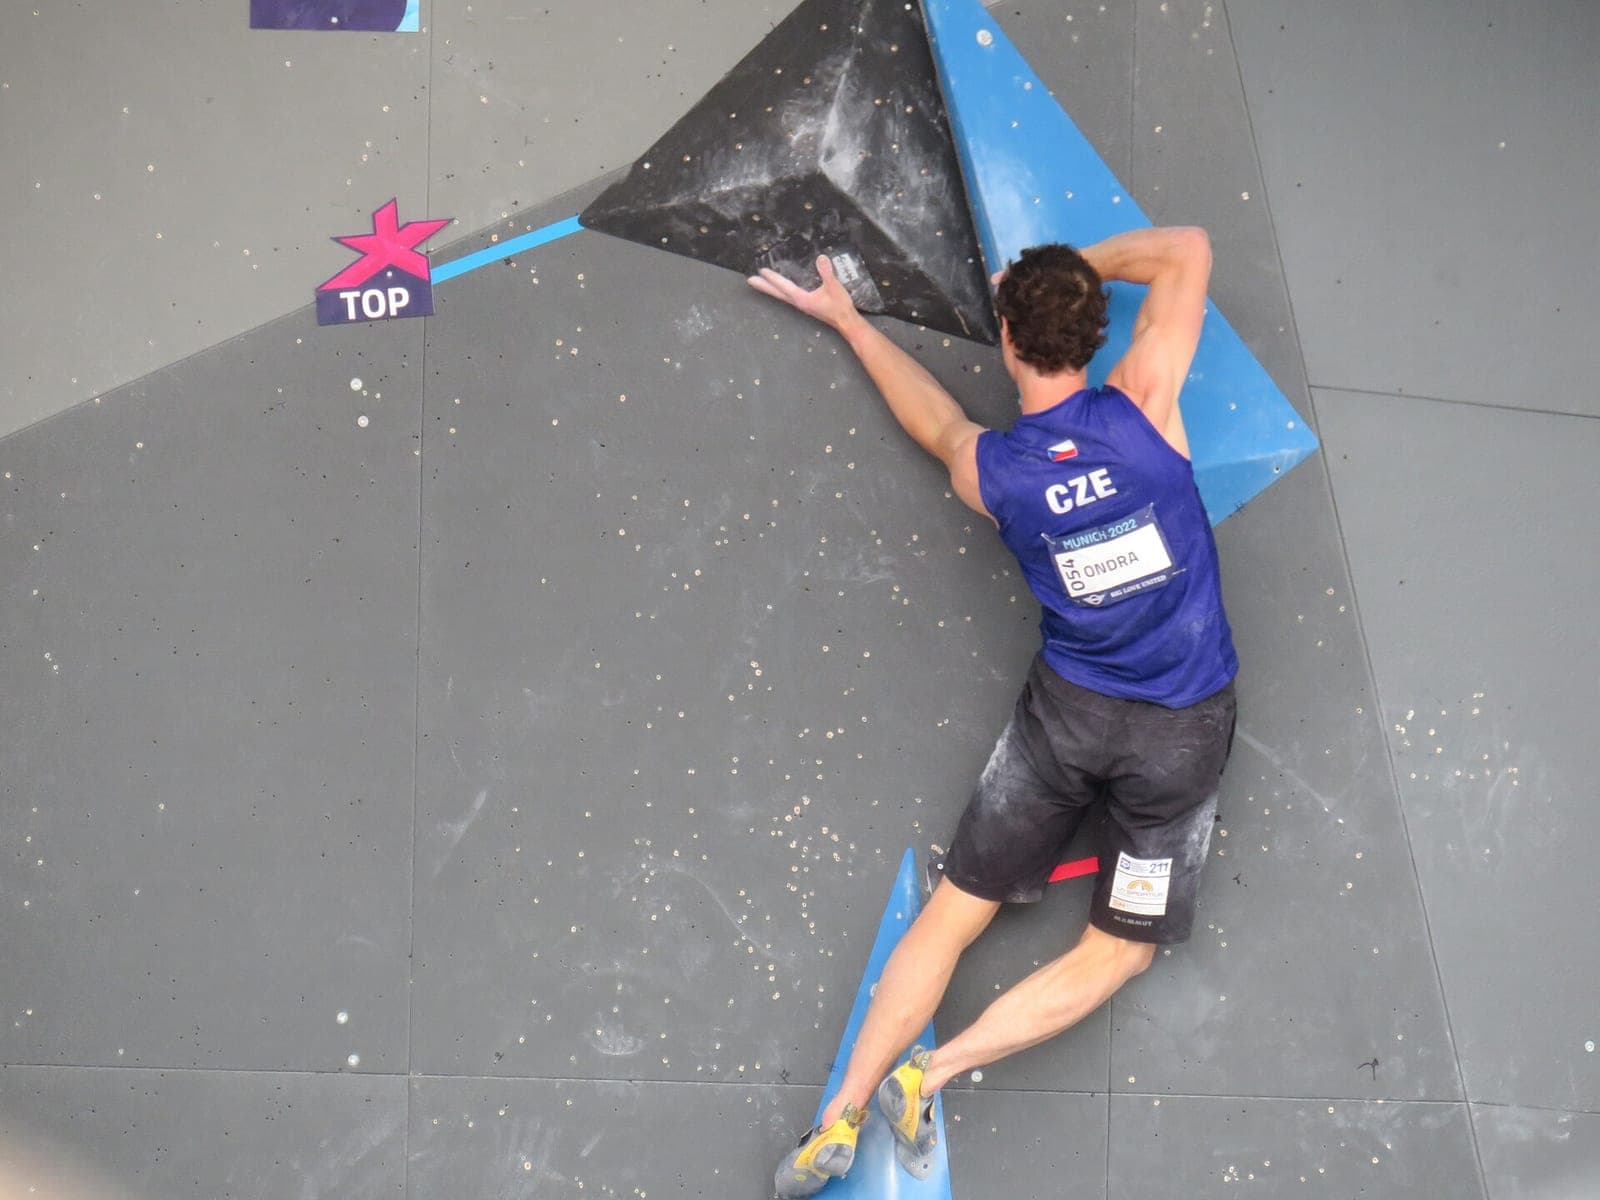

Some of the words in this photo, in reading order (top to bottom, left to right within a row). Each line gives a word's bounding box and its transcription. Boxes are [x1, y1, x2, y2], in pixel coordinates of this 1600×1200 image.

[339, 287, 410, 320] TOP
[1045, 468, 1118, 515] CZE
[1062, 531, 1107, 550] MUNICH
[1108, 518, 1138, 538] 2022
[1062, 558, 1086, 592] 054
[1083, 551, 1140, 578] ONDRA
[1148, 862, 1169, 874] 211
